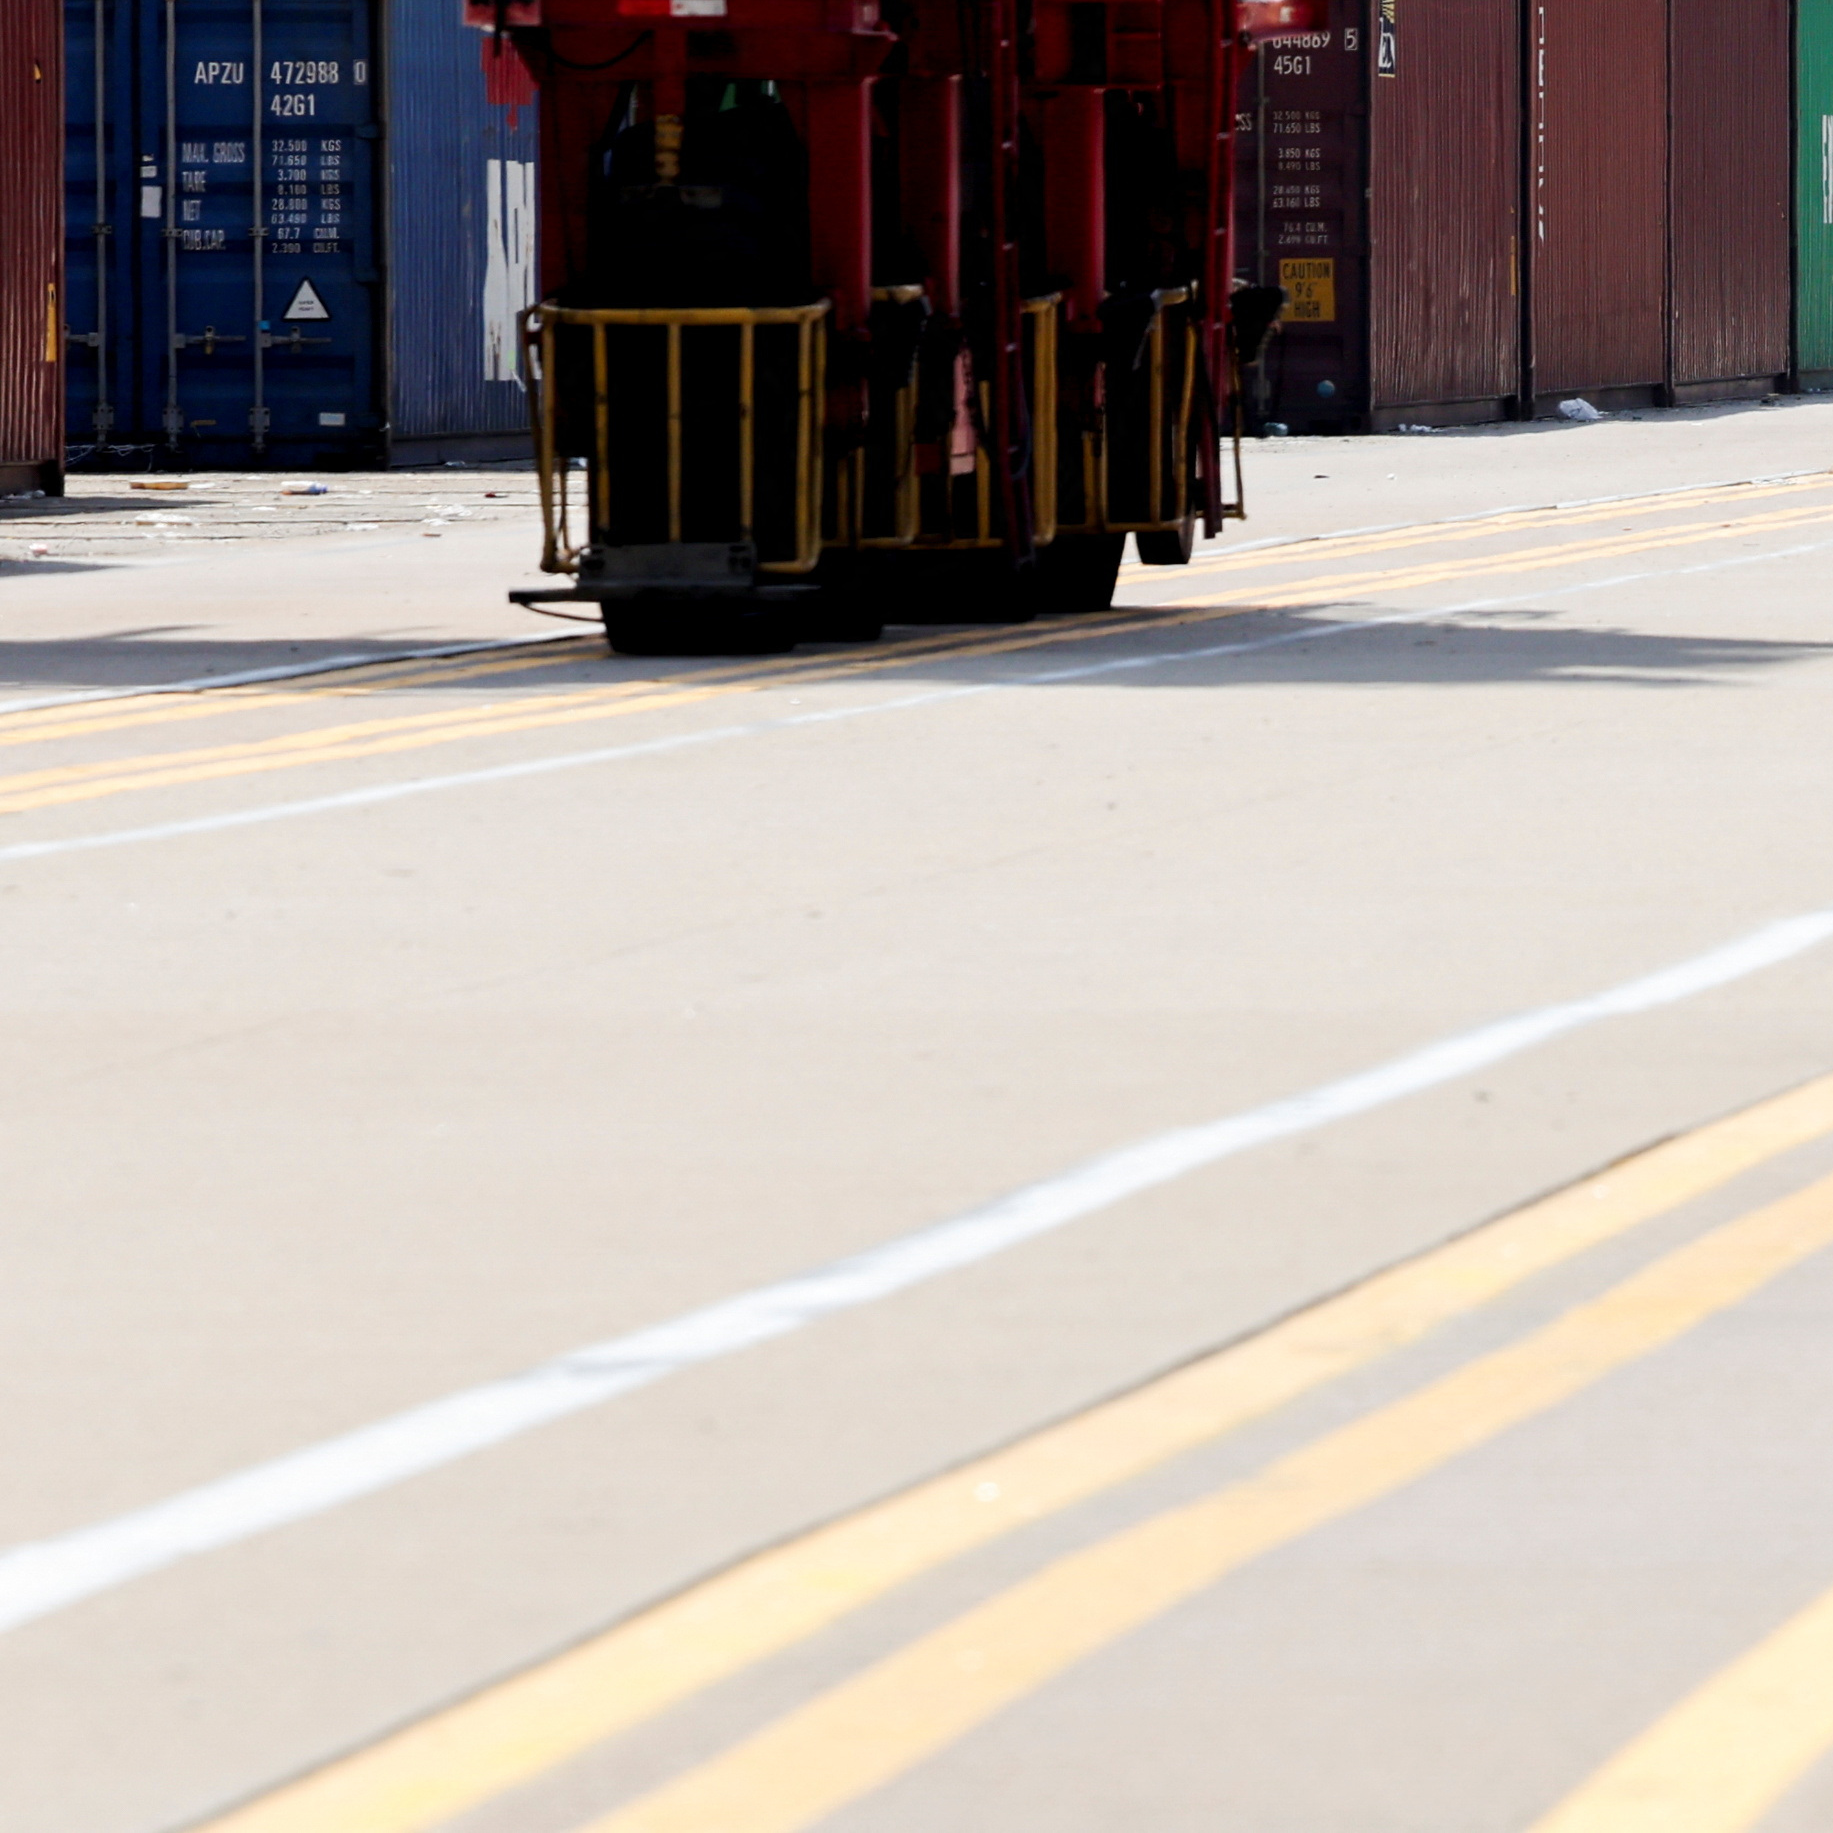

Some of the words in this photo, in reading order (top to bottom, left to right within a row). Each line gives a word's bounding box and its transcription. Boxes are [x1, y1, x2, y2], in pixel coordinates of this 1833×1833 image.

[1345, 28, 1357, 50] 5
[194, 61, 244, 85] APZU
[270, 61, 339, 85] 472988
[1273, 55, 1311, 75] 45G1
[270, 94, 315, 116] 42G1
[212, 142, 245, 163] GROSS
[321, 140, 341, 152] KGS
[321, 155, 340, 166] LBS
[182, 170, 206, 192] TARE
[321, 184, 340, 195] LBS
[182, 200, 201, 221] NET
[321, 199, 341, 210] KGS
[321, 213, 340, 224] LBS
[1281, 262, 1331, 279] CAUTION
[1294, 301, 1321, 318] HIGH
